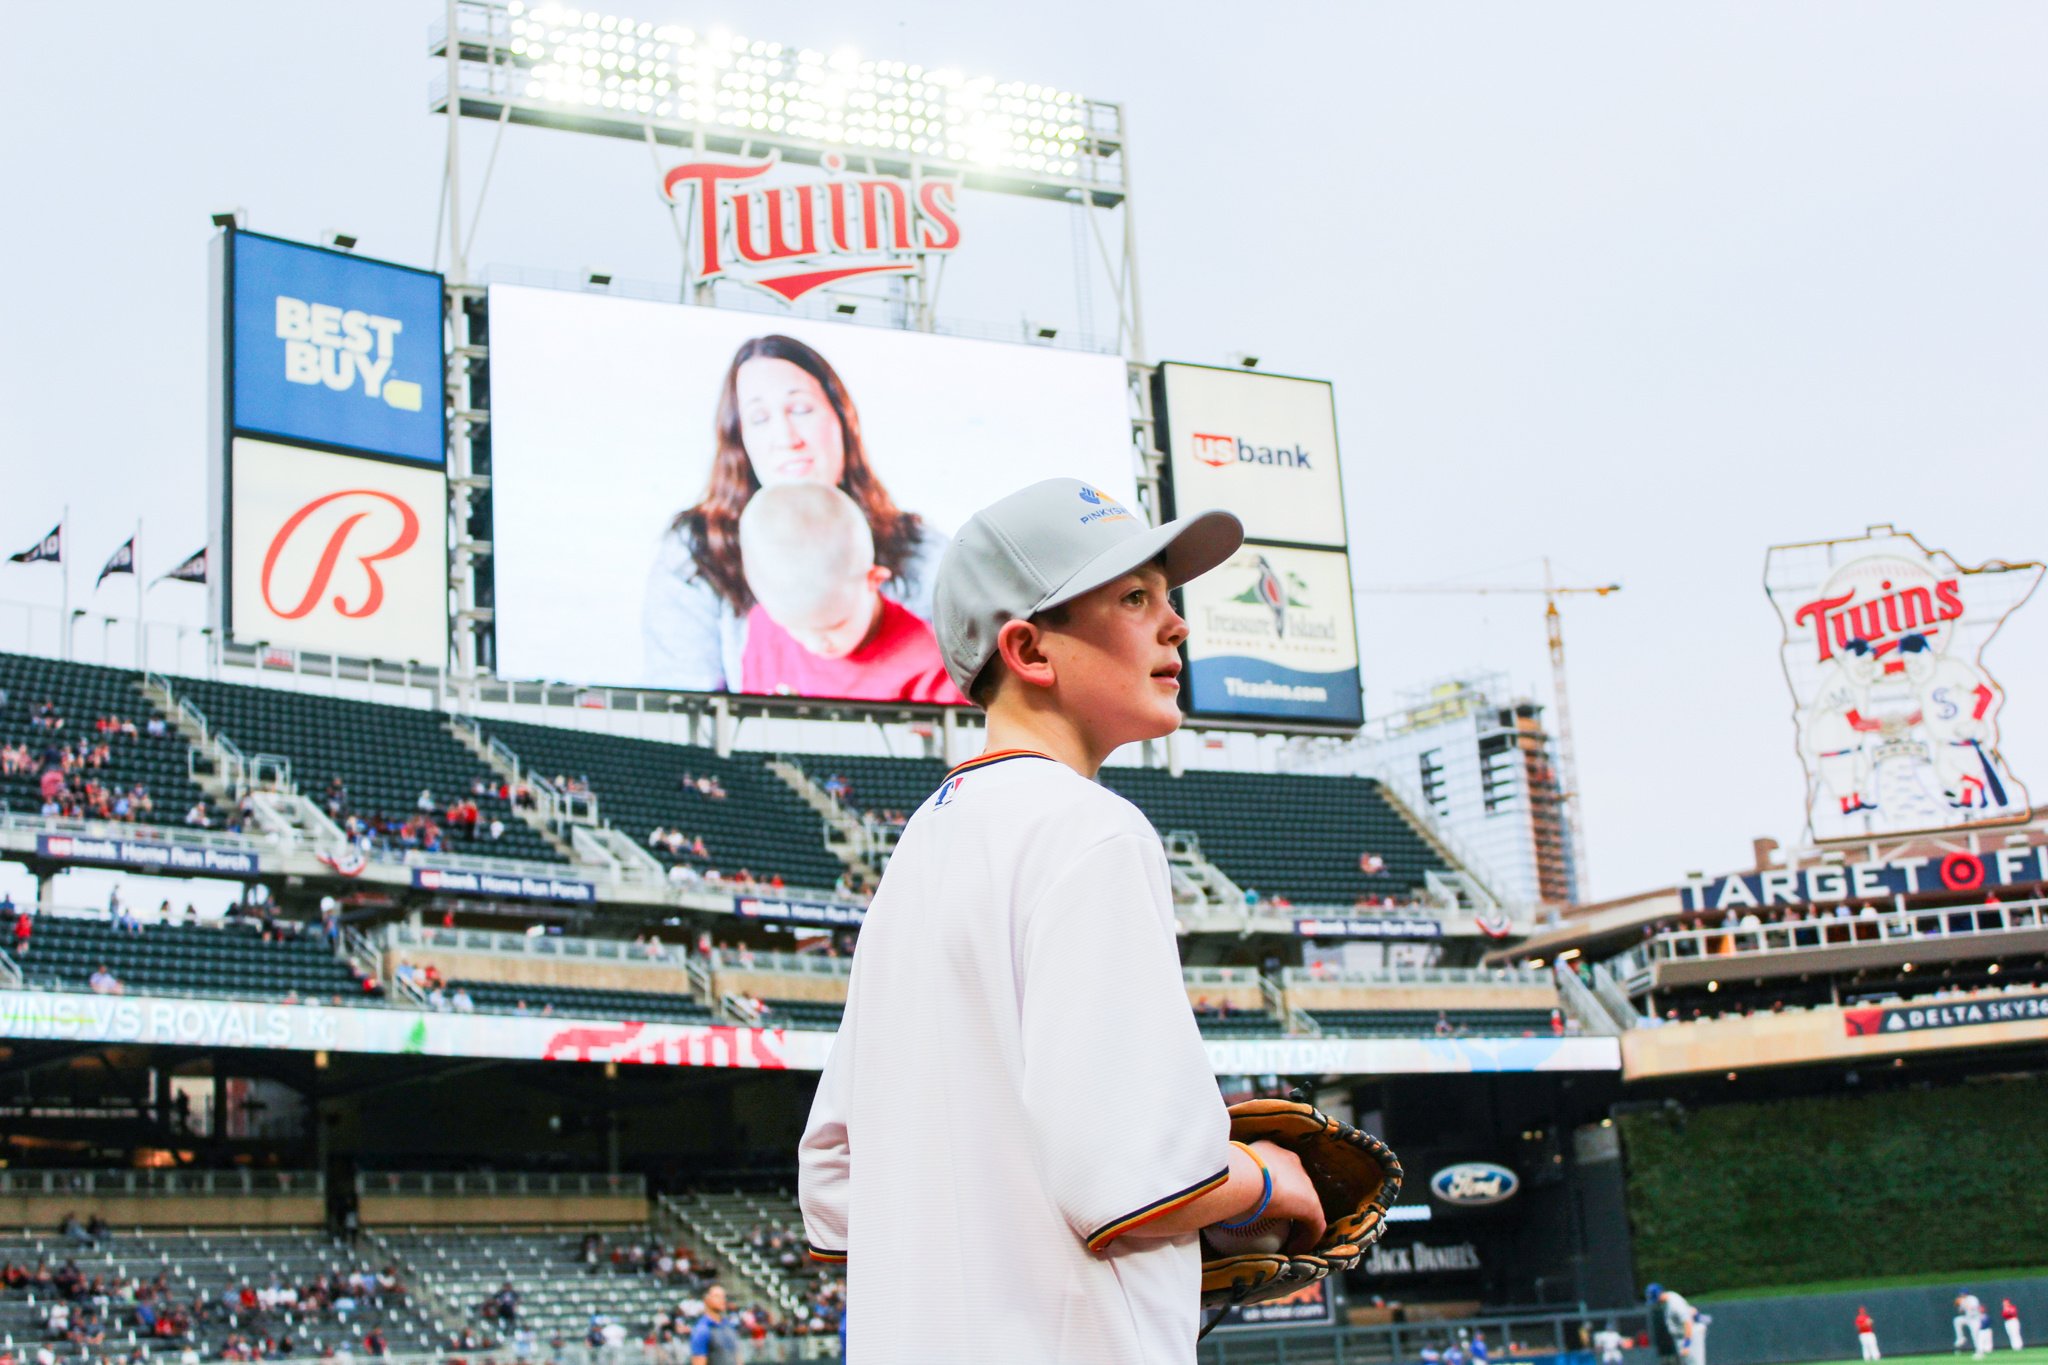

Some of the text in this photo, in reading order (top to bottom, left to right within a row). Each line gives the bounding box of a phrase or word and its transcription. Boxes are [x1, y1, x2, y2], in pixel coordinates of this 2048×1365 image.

[662, 150, 962, 279] Twins
[276, 295, 403, 357] BEST
[285, 339, 393, 398] BUY
[261, 489, 420, 620] B
[1288, 612, 1337, 641] Island
[1795, 580, 1964, 663] Twins
[121, 842, 169, 863] Home
[171, 846, 203, 866] Run
[205, 849, 251, 871] Porch
[1681, 845, 2048, 911] TARGET FI
[481, 874, 521, 894] Home
[522, 877, 549, 897] Run
[87, 999, 142, 1041] VS
[149, 1002, 292, 1047] ROYALS
[1908, 998, 2048, 1028] DELTA SKY36
[1448, 1169, 1502, 1199] Ford
